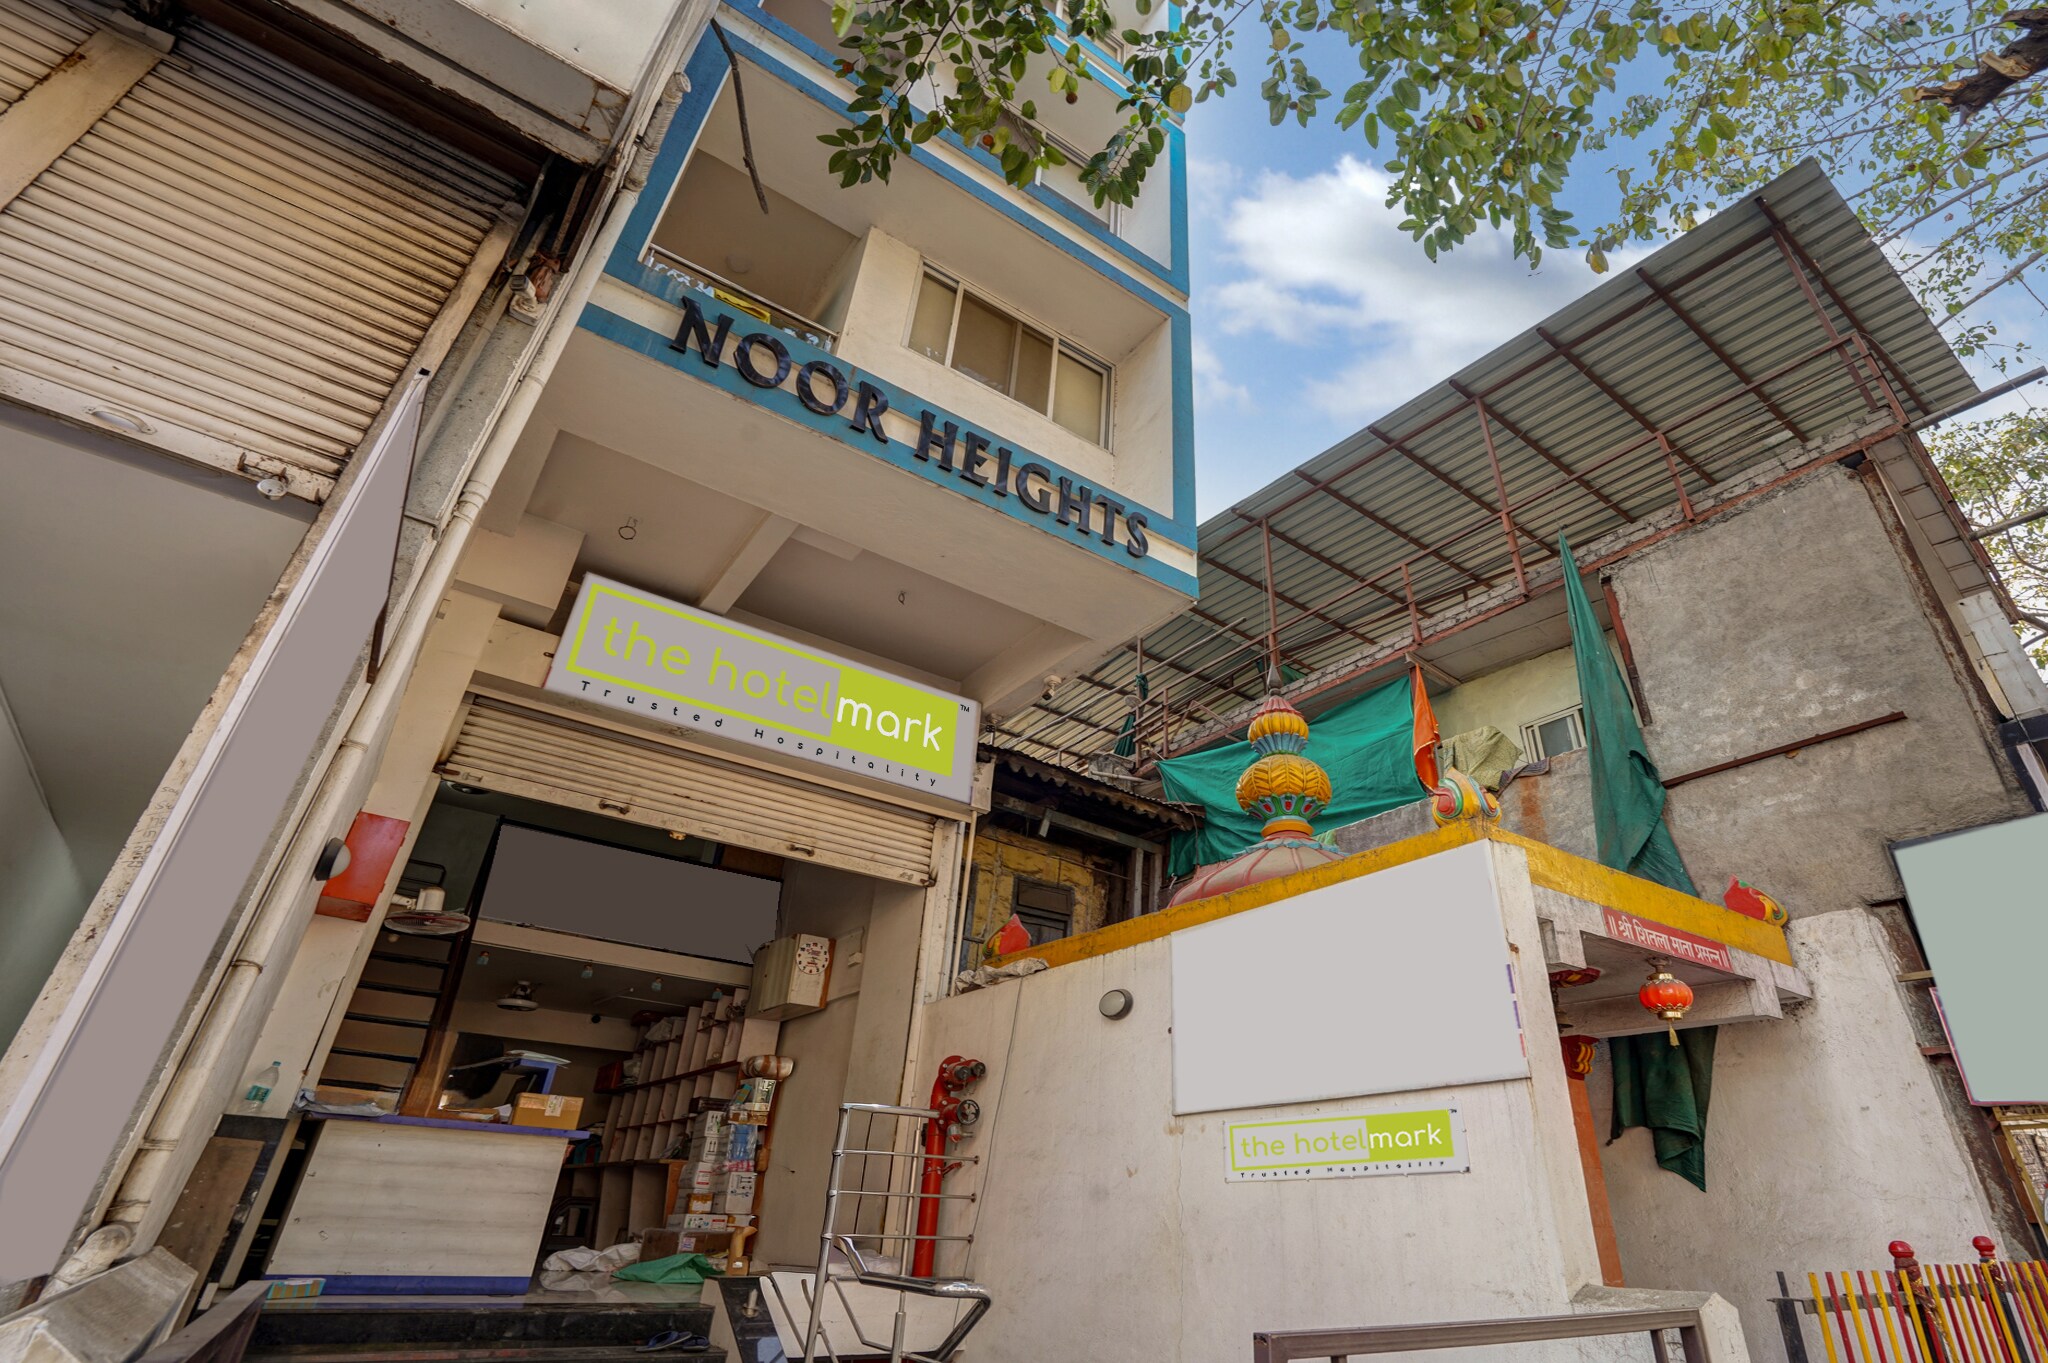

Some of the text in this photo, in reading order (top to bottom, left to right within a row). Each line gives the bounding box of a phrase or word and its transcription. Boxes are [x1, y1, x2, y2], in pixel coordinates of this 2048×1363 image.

[668, 296, 1149, 559] NOOR HEIGHTS
[603, 616, 691, 676] the
[580, 680, 937, 787] Trusted Hospitality
[1671, 936, 1694, 957] माता
[1240, 1135, 1286, 1158] the
[1240, 1168, 1311, 1178] Trusted
